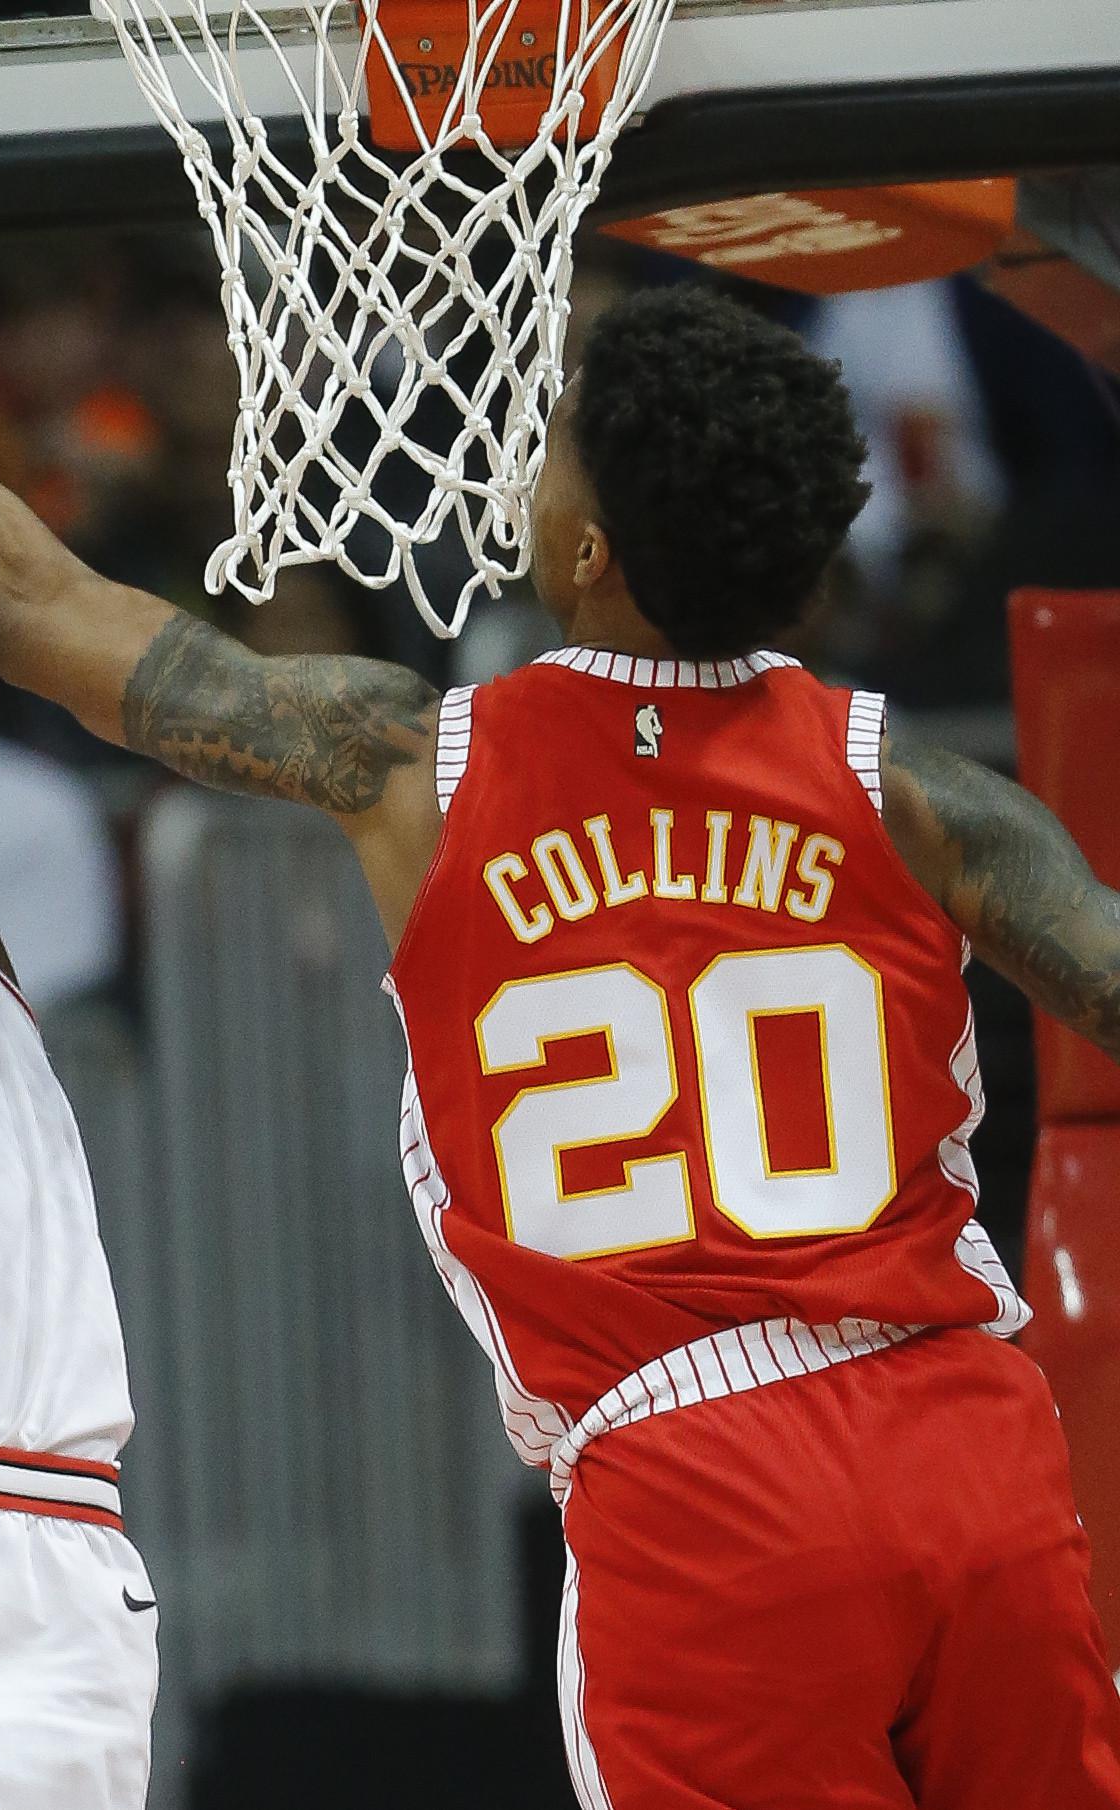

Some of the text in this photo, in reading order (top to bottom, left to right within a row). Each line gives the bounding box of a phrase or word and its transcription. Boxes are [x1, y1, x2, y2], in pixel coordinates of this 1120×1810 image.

[398, 53, 556, 97] SPADING
[482, 808, 847, 944] COLLINS
[474, 942, 898, 1262] 20
